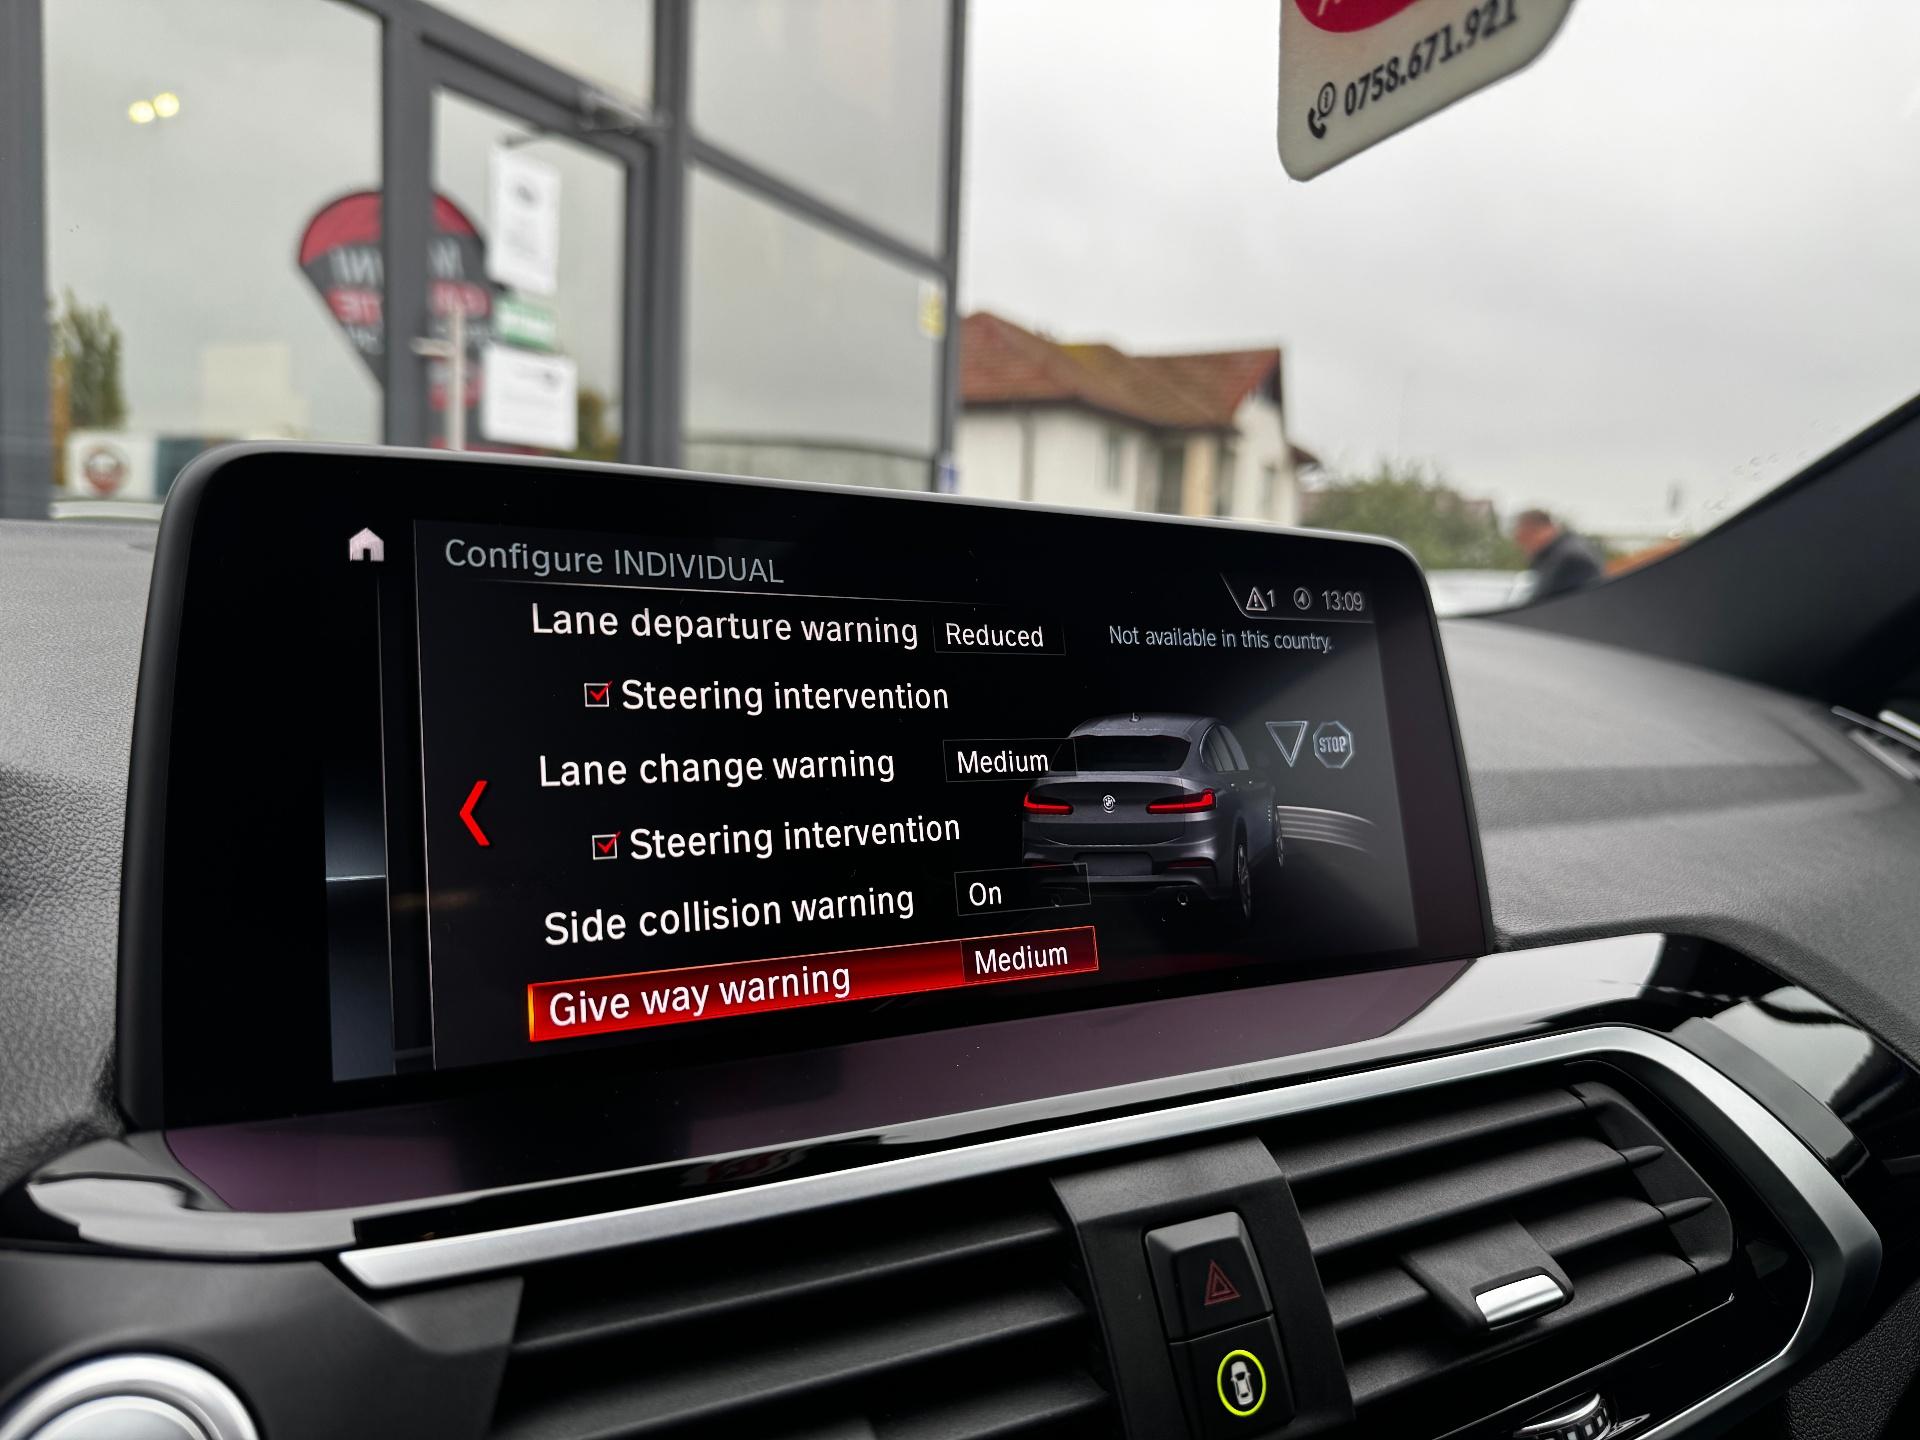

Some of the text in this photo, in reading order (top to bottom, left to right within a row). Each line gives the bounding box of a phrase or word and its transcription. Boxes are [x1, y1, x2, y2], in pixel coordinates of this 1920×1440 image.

[445, 538, 785, 584] Configure INDIVIDUAL
[1267, 589, 1276, 608] 1
[1321, 590, 1365, 612] 13:09
[531, 602, 919, 651] Lane departure warning
[945, 621, 1045, 648] Reduced
[1109, 625, 1333, 655] Not available in this country.
[621, 678, 950, 717] Steering intervention
[1318, 735, 1347, 754] STOP
[539, 749, 896, 789] Lane change warning
[956, 750, 1050, 775] Medium
[629, 814, 961, 861] Steering intervention
[968, 881, 1003, 906] On
[544, 887, 915, 947] Side collision warning
[974, 944, 1069, 976] Medium
[549, 964, 852, 1028] Give way warning
